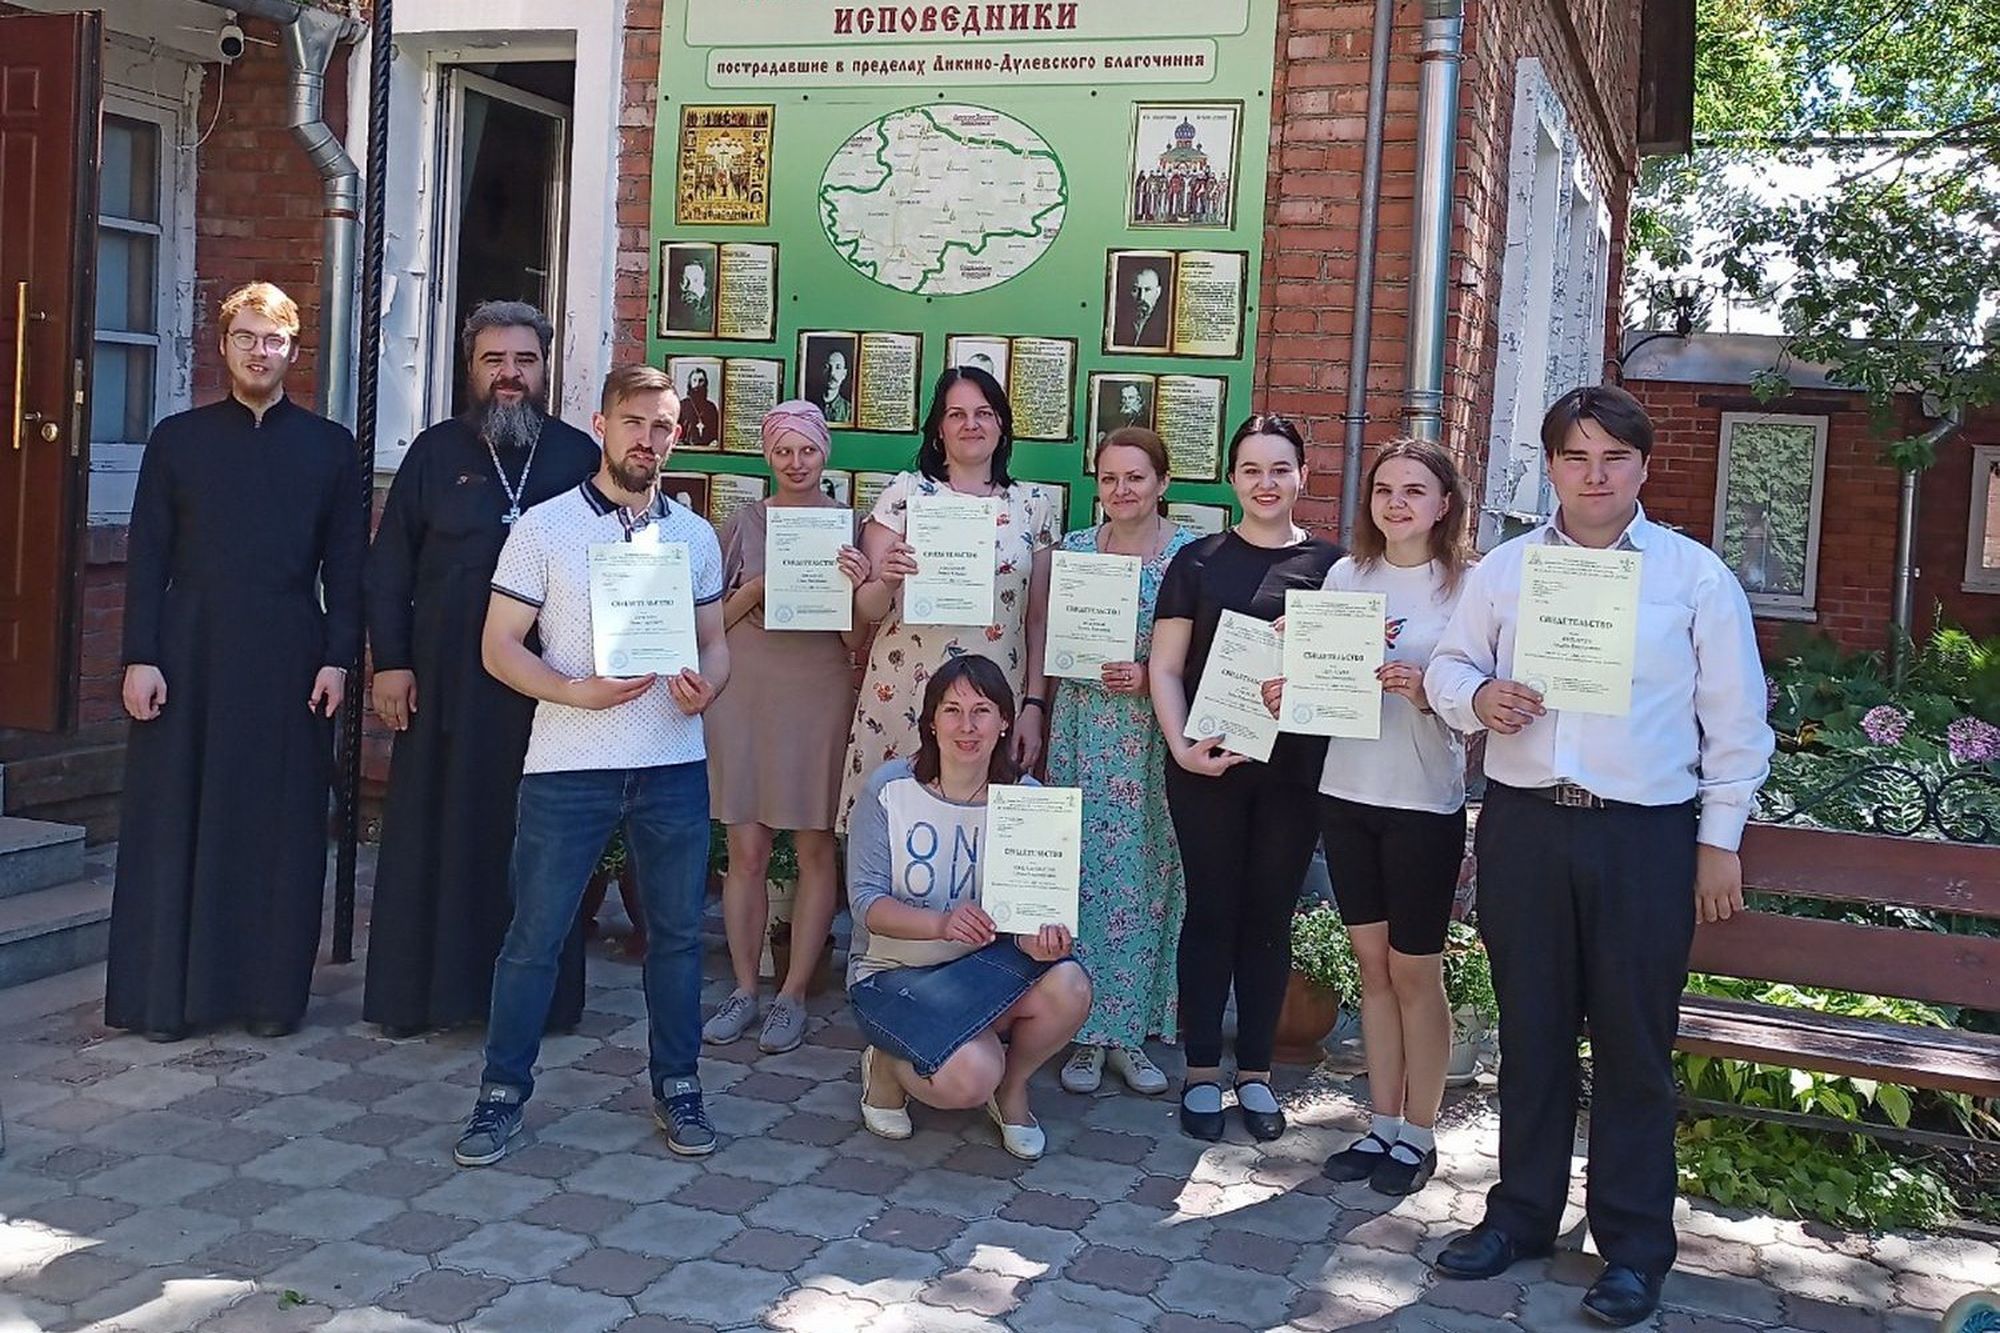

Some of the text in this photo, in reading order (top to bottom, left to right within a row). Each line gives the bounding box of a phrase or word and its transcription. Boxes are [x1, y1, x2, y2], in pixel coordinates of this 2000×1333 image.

[833, 3, 1078, 36] ИСПОВЕДНИКИ
[716, 60, 829, 77] пострадавшие
[835, 61, 844, 73] в
[852, 58, 925, 76] пределах
[1104, 54, 1205, 70] благочиния
